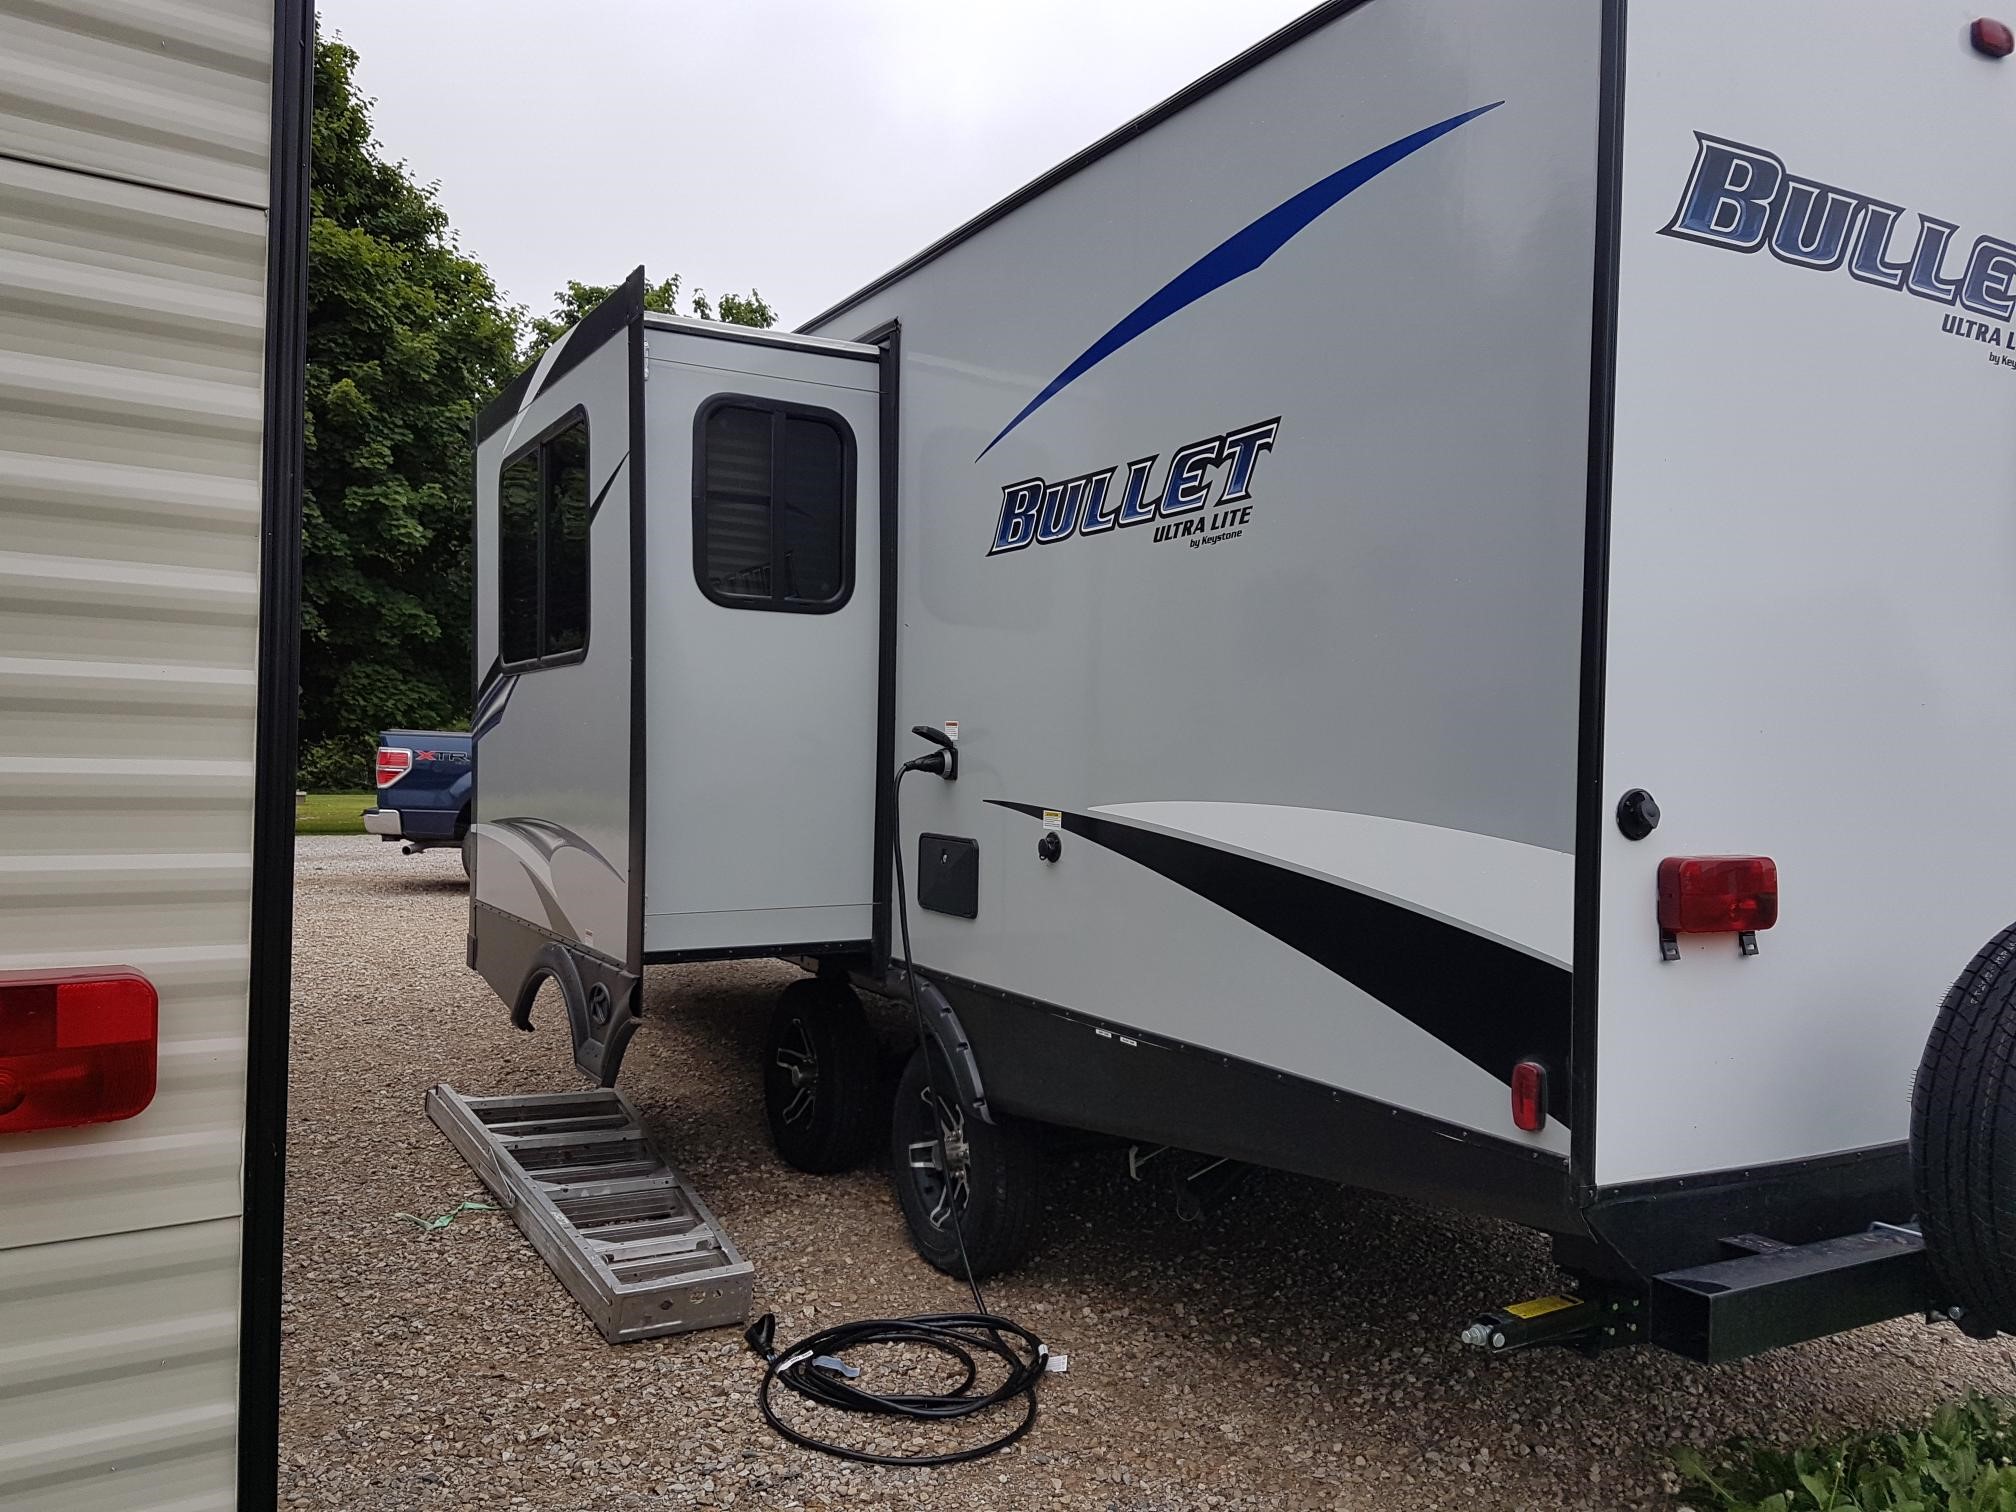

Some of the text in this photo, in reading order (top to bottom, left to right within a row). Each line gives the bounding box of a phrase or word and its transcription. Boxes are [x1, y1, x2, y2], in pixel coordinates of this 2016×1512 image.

[1656, 130, 2016, 323] BULLE
[1941, 313, 2001, 346] ULTRA
[1989, 351, 2001, 366] by
[985, 416, 1281, 557] BULLET
[1153, 505, 1253, 543] ULTRA LITE
[1190, 529, 1243, 549] by Keystone
[414, 749, 470, 761] XTR
